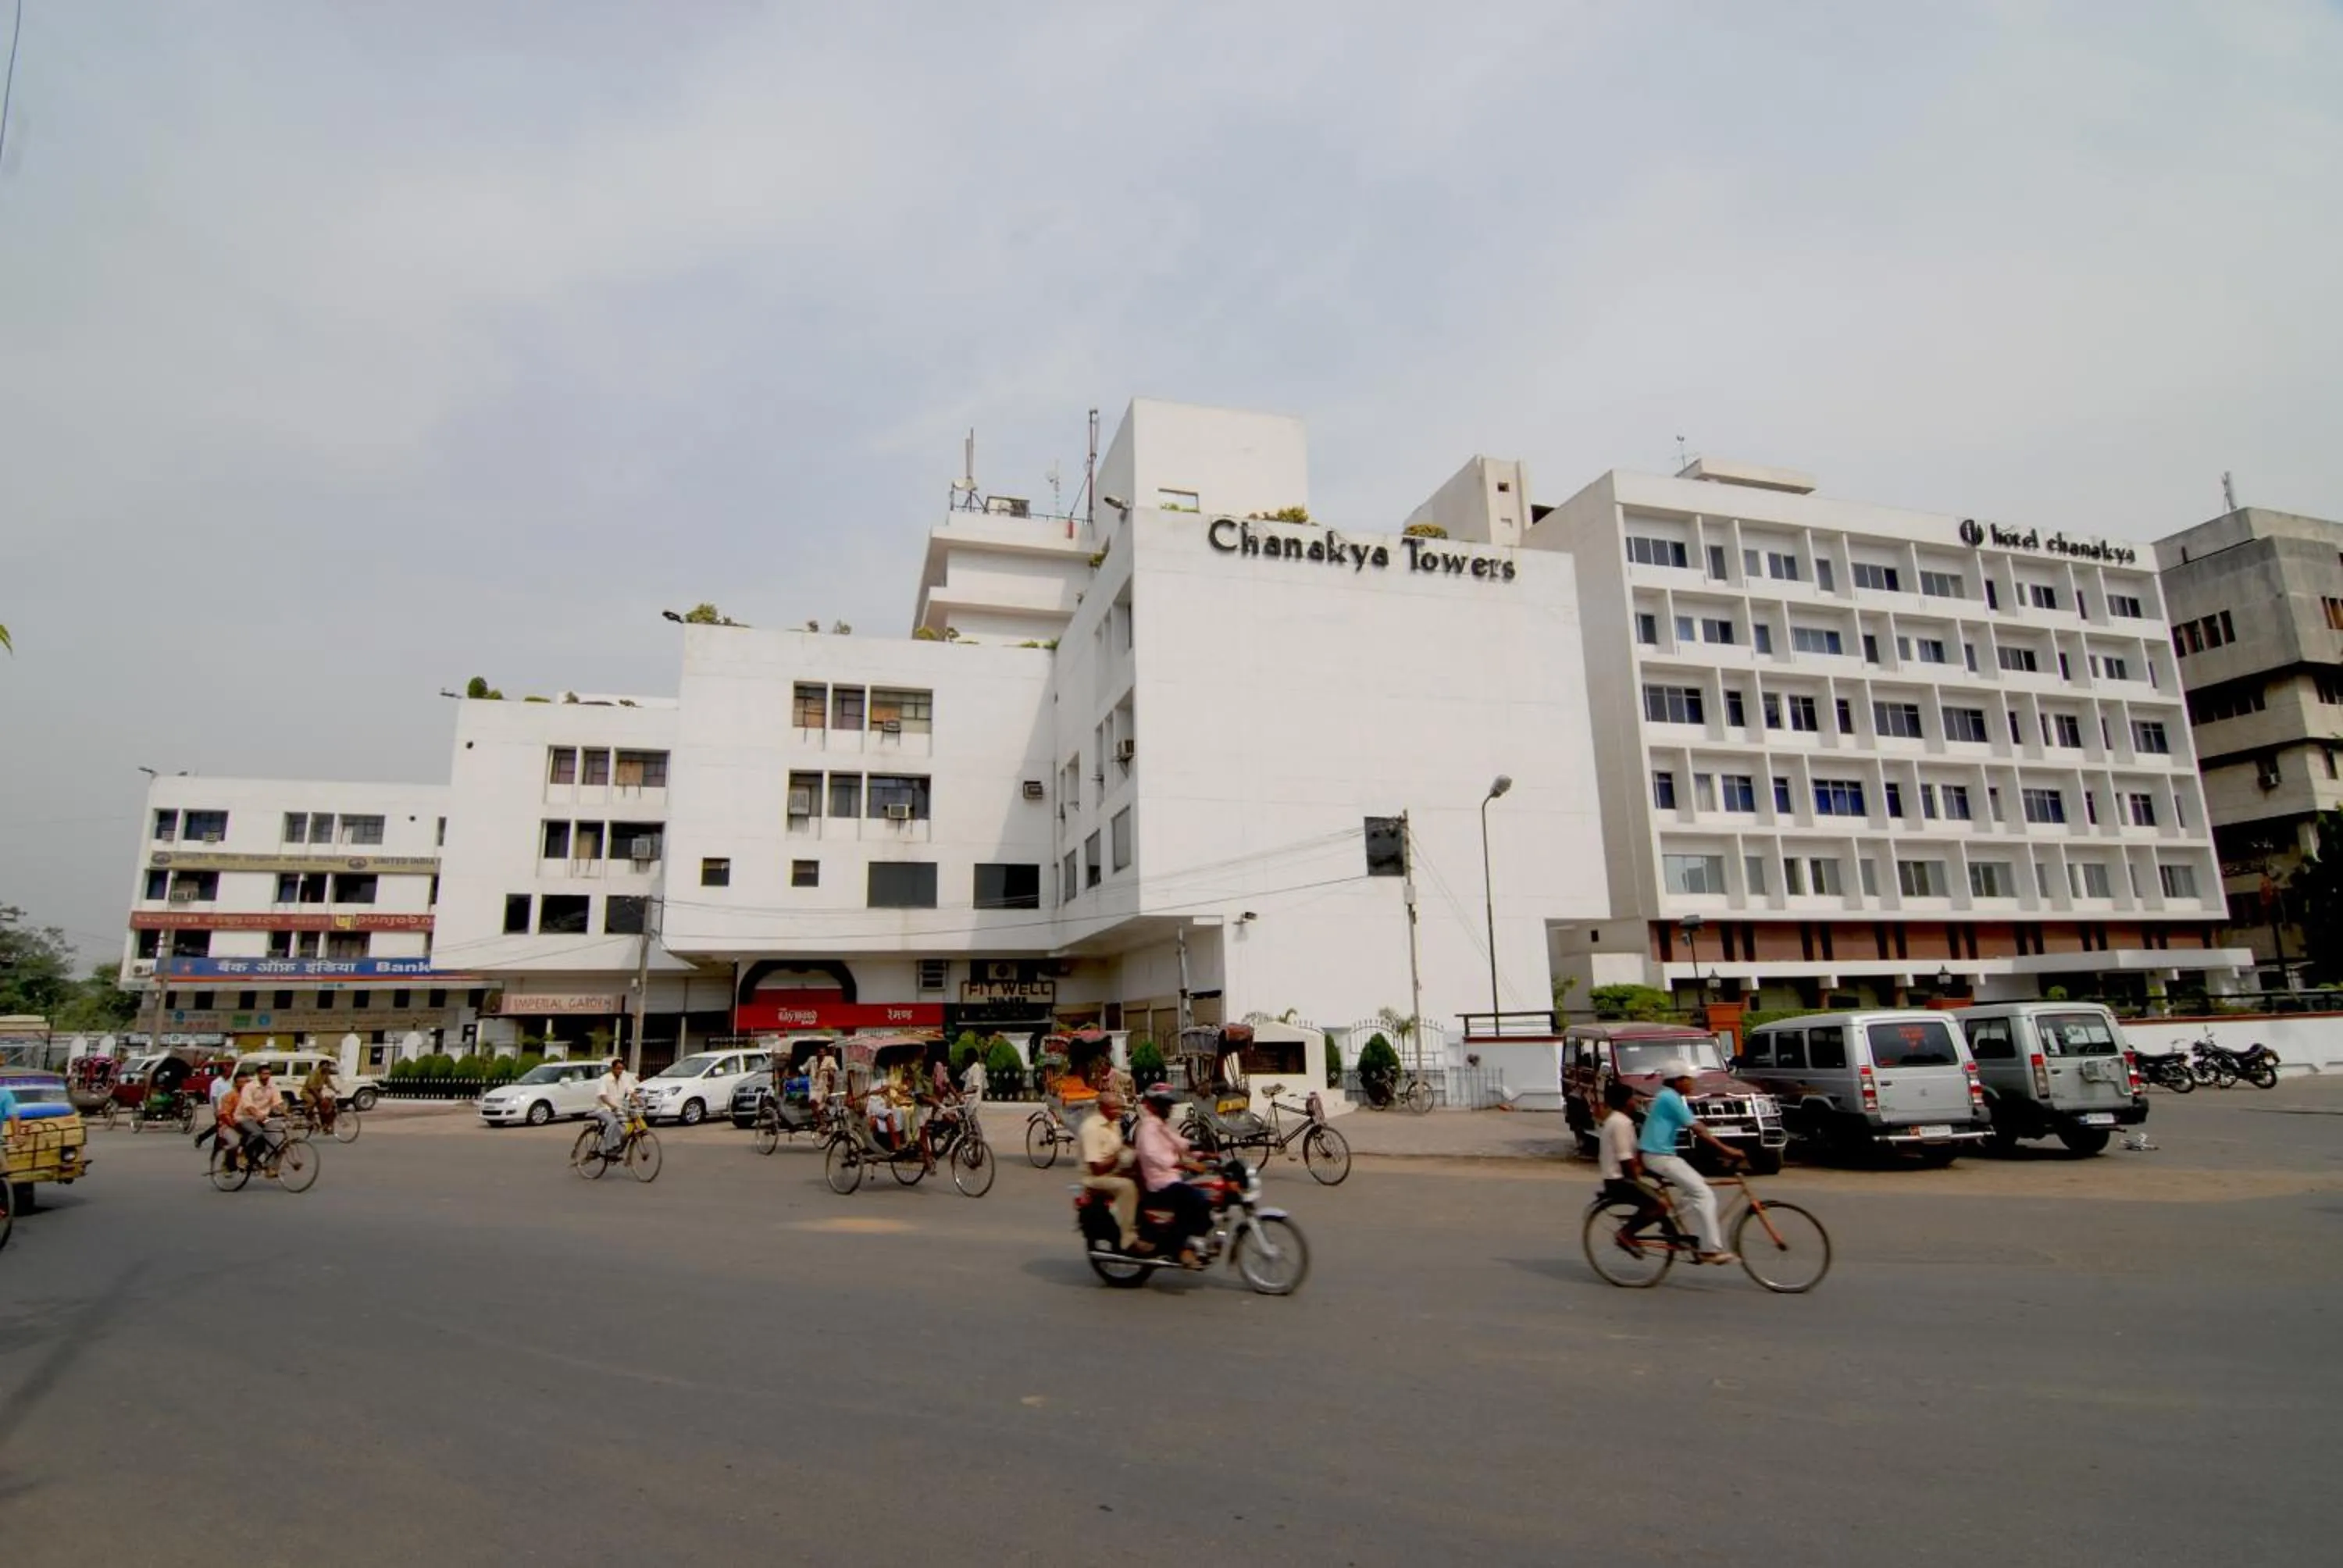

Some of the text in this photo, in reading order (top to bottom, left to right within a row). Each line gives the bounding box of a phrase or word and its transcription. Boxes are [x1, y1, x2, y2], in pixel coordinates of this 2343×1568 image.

[1207, 519, 1516, 580] Chanakya Towers
[1989, 522, 2136, 565] hotel chanakya
[410, 857, 435, 865] INDIA
[376, 961, 431, 973] Bank
[514, 996, 612, 1010] IMPERIAL GARDEN
